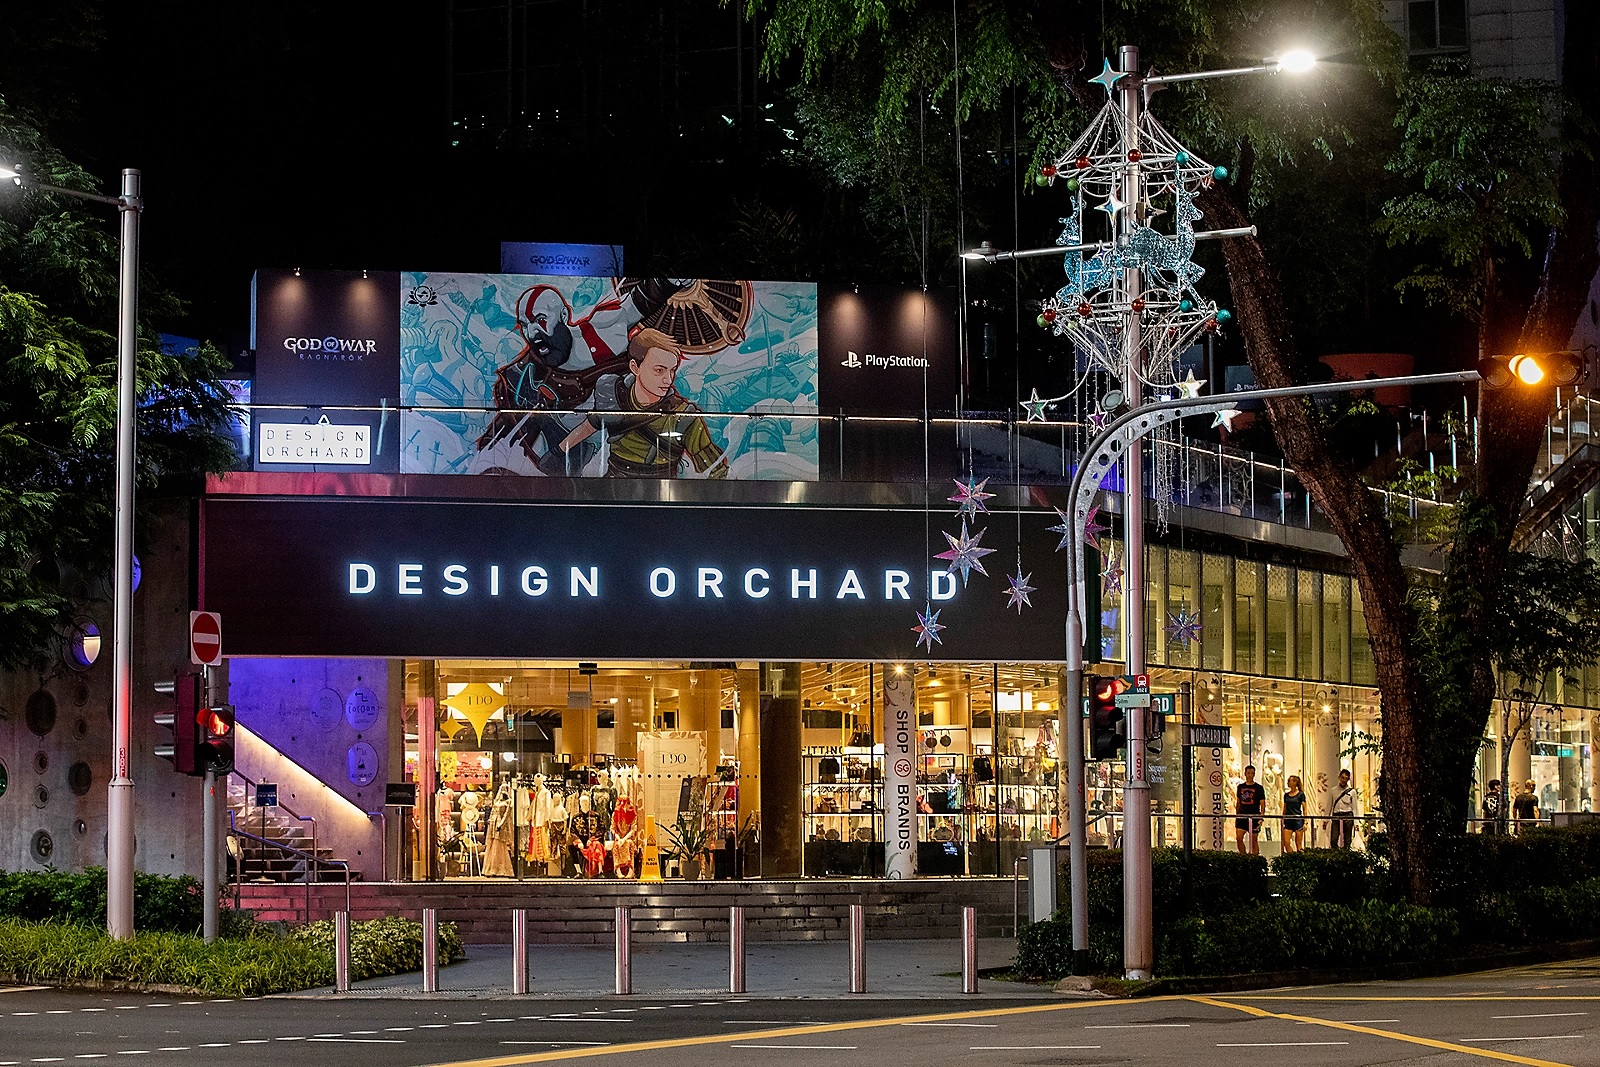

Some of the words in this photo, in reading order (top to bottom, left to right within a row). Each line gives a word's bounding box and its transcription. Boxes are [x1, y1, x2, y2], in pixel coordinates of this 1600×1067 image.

[529, 255, 554, 266] GOD
[564, 256, 590, 267] WAR
[283, 337, 322, 354] GOD
[338, 339, 378, 356] WAR
[266, 429, 364, 442] DESIGN
[266, 446, 364, 459] ORCHARD
[349, 563, 599, 597] DESIGN
[649, 567, 957, 600] ORCHARD
[896, 710, 908, 754] SHOP
[1195, 728, 1220, 743] ORCHARD
[1221, 729, 1229, 744] RD
[897, 785, 910, 850] BRANDS
